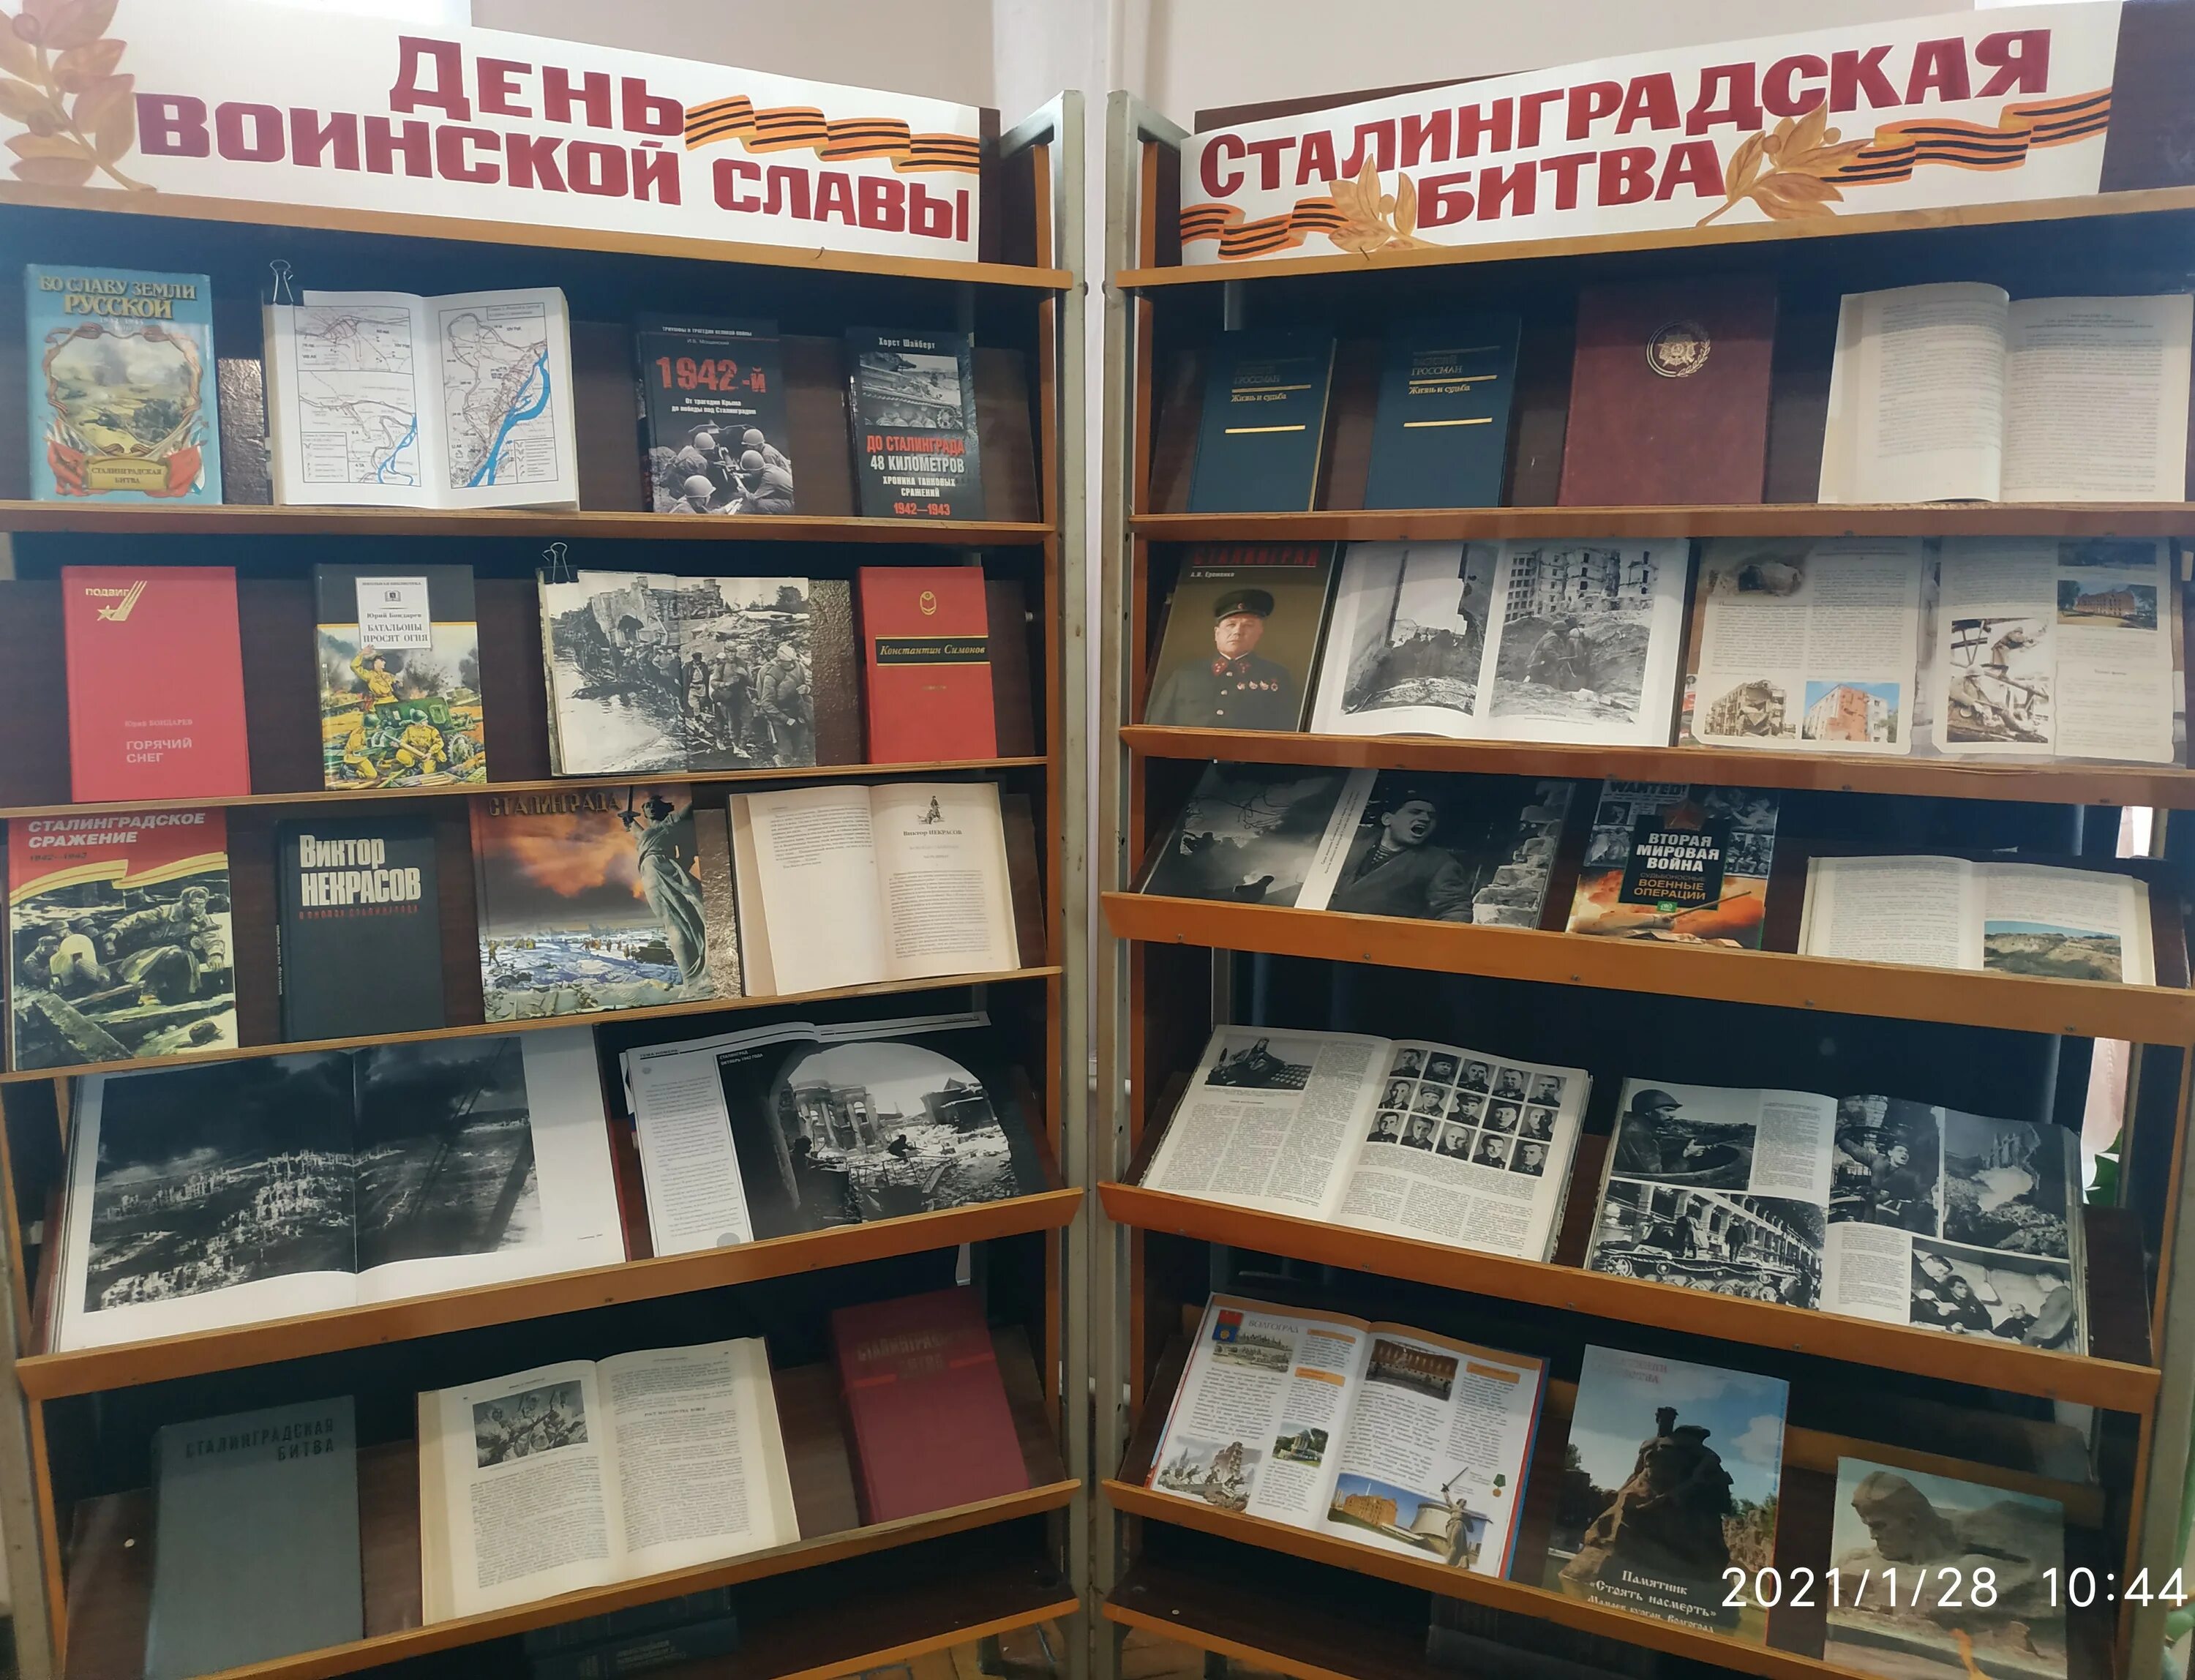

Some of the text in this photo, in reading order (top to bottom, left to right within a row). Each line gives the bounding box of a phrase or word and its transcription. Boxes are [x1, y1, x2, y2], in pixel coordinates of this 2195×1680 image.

[389, 35, 684, 137] ДЕНЬ
[1200, 29, 2051, 198] СТАЛИНГРАДСКАЯ
[135, 92, 969, 242] ВОИНСКОЙ СЛАВЫ
[1417, 139, 1727, 229] БИТВА
[67, 277, 127, 295] СЛАВУ
[132, 282, 197, 300] ЗЕМЛИ
[64, 293, 173, 319] РУССКОЙ
[879, 337, 936, 350] Хорст Шайберт
[656, 356, 766, 393] 1942-й
[1411, 366, 1463, 376] ГРОССМАН
[1408, 385, 1436, 396] Жизнь
[1446, 383, 1471, 395] судьба
[694, 398, 721, 406] трагедии
[1230, 394, 1256, 404] Жизнь
[1264, 392, 1287, 402] судьба
[866, 435, 965, 455] ДО СТАЛИНГРАДА
[870, 454, 965, 473] 48 КИЛОМЕТРОВ
[882, 476, 956, 487] ХРОНИКА ТАНКОВЫХ
[901, 487, 940, 498] СРАЖЕНИЙ
[86, 588, 130, 597] ПОДВИГ
[368, 623, 422, 631] БАТАЛЬОНЫ
[364, 634, 399, 642] ПРОСЯТ
[880, 644, 986, 656] Константин Симонов
[126, 738, 192, 750] ГОРЯЧИЙ
[127, 753, 164, 763] СНЕГ
[29, 813, 206, 833] СТАЛИНГРАДСКОЕ
[29, 831, 138, 849] СРАЖЕНИЕ
[1648, 833, 1713, 847] ВТОРАЯ
[299, 834, 386, 869] Виктор
[1636, 844, 1720, 860] МИРОВАЯ
[1646, 857, 1704, 872] ВОЙНА
[301, 868, 421, 907] НЕКРАСОВ
[1638, 879, 1705, 890] ВОЕННЫЕ
[1634, 888, 1706, 901] ОПЕРАЦИИ
[278, 1438, 334, 1461] БИТВА
[1622, 1570, 1687, 1595] Памятник
[1648, 1595, 1716, 1617] насмерть»
